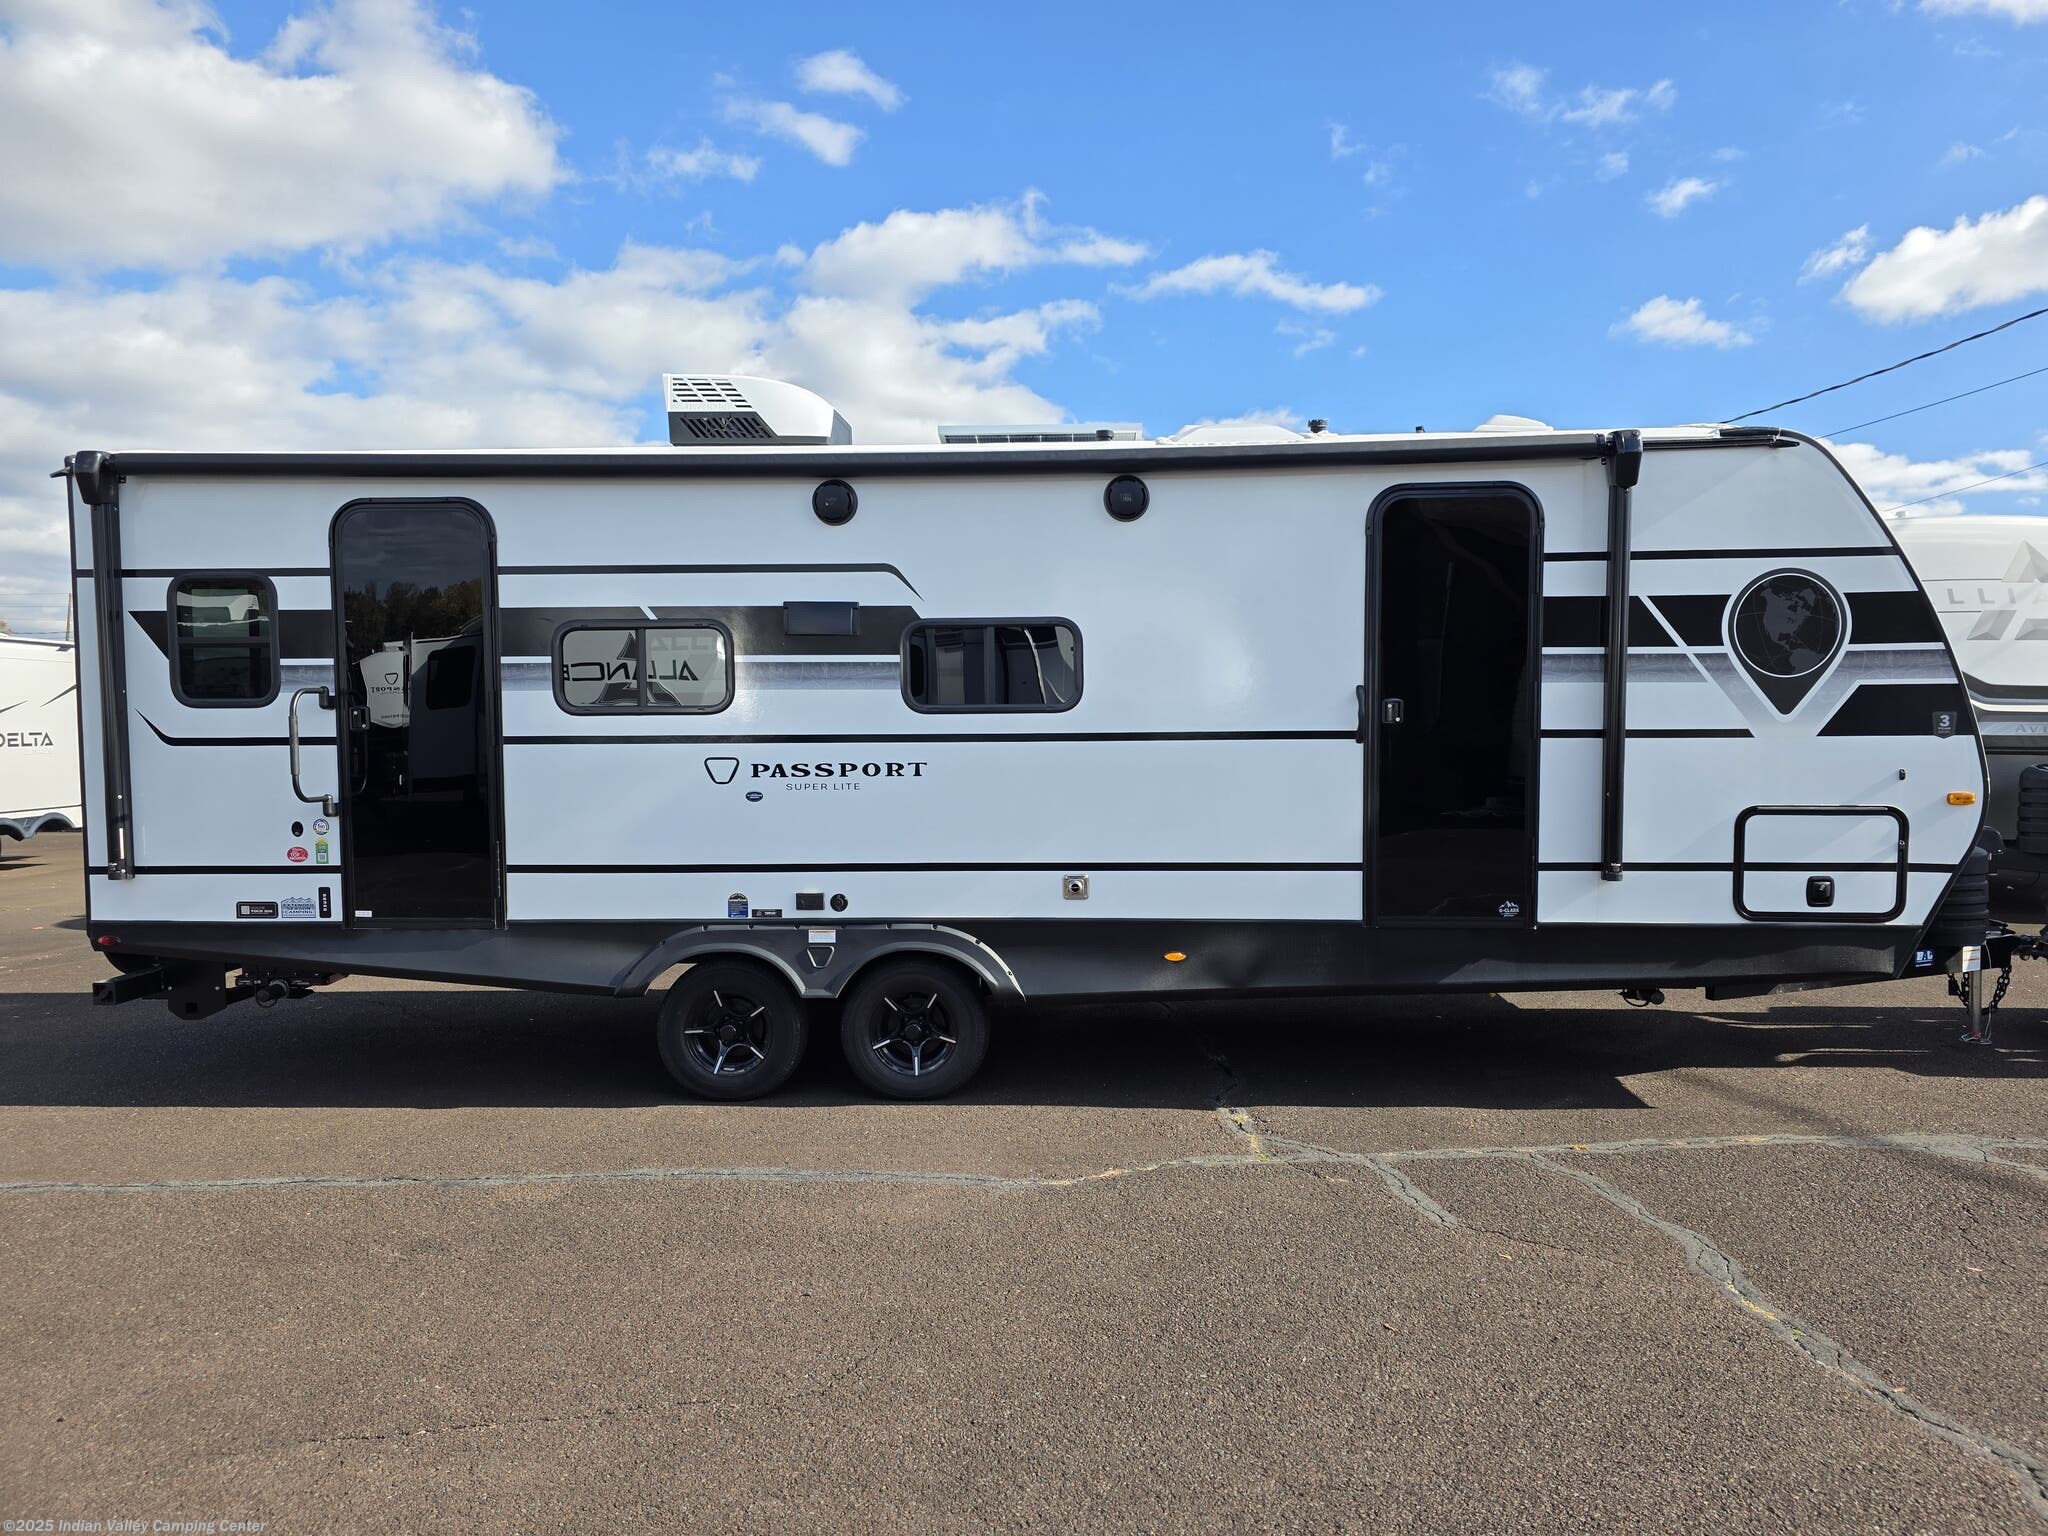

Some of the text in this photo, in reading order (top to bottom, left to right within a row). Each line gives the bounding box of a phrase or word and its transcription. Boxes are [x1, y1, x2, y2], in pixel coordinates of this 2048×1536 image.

[1939, 714, 1950, 727] 3
[751, 762, 928, 778] PASSPORT
[785, 782, 861, 791] SUPER LITE
